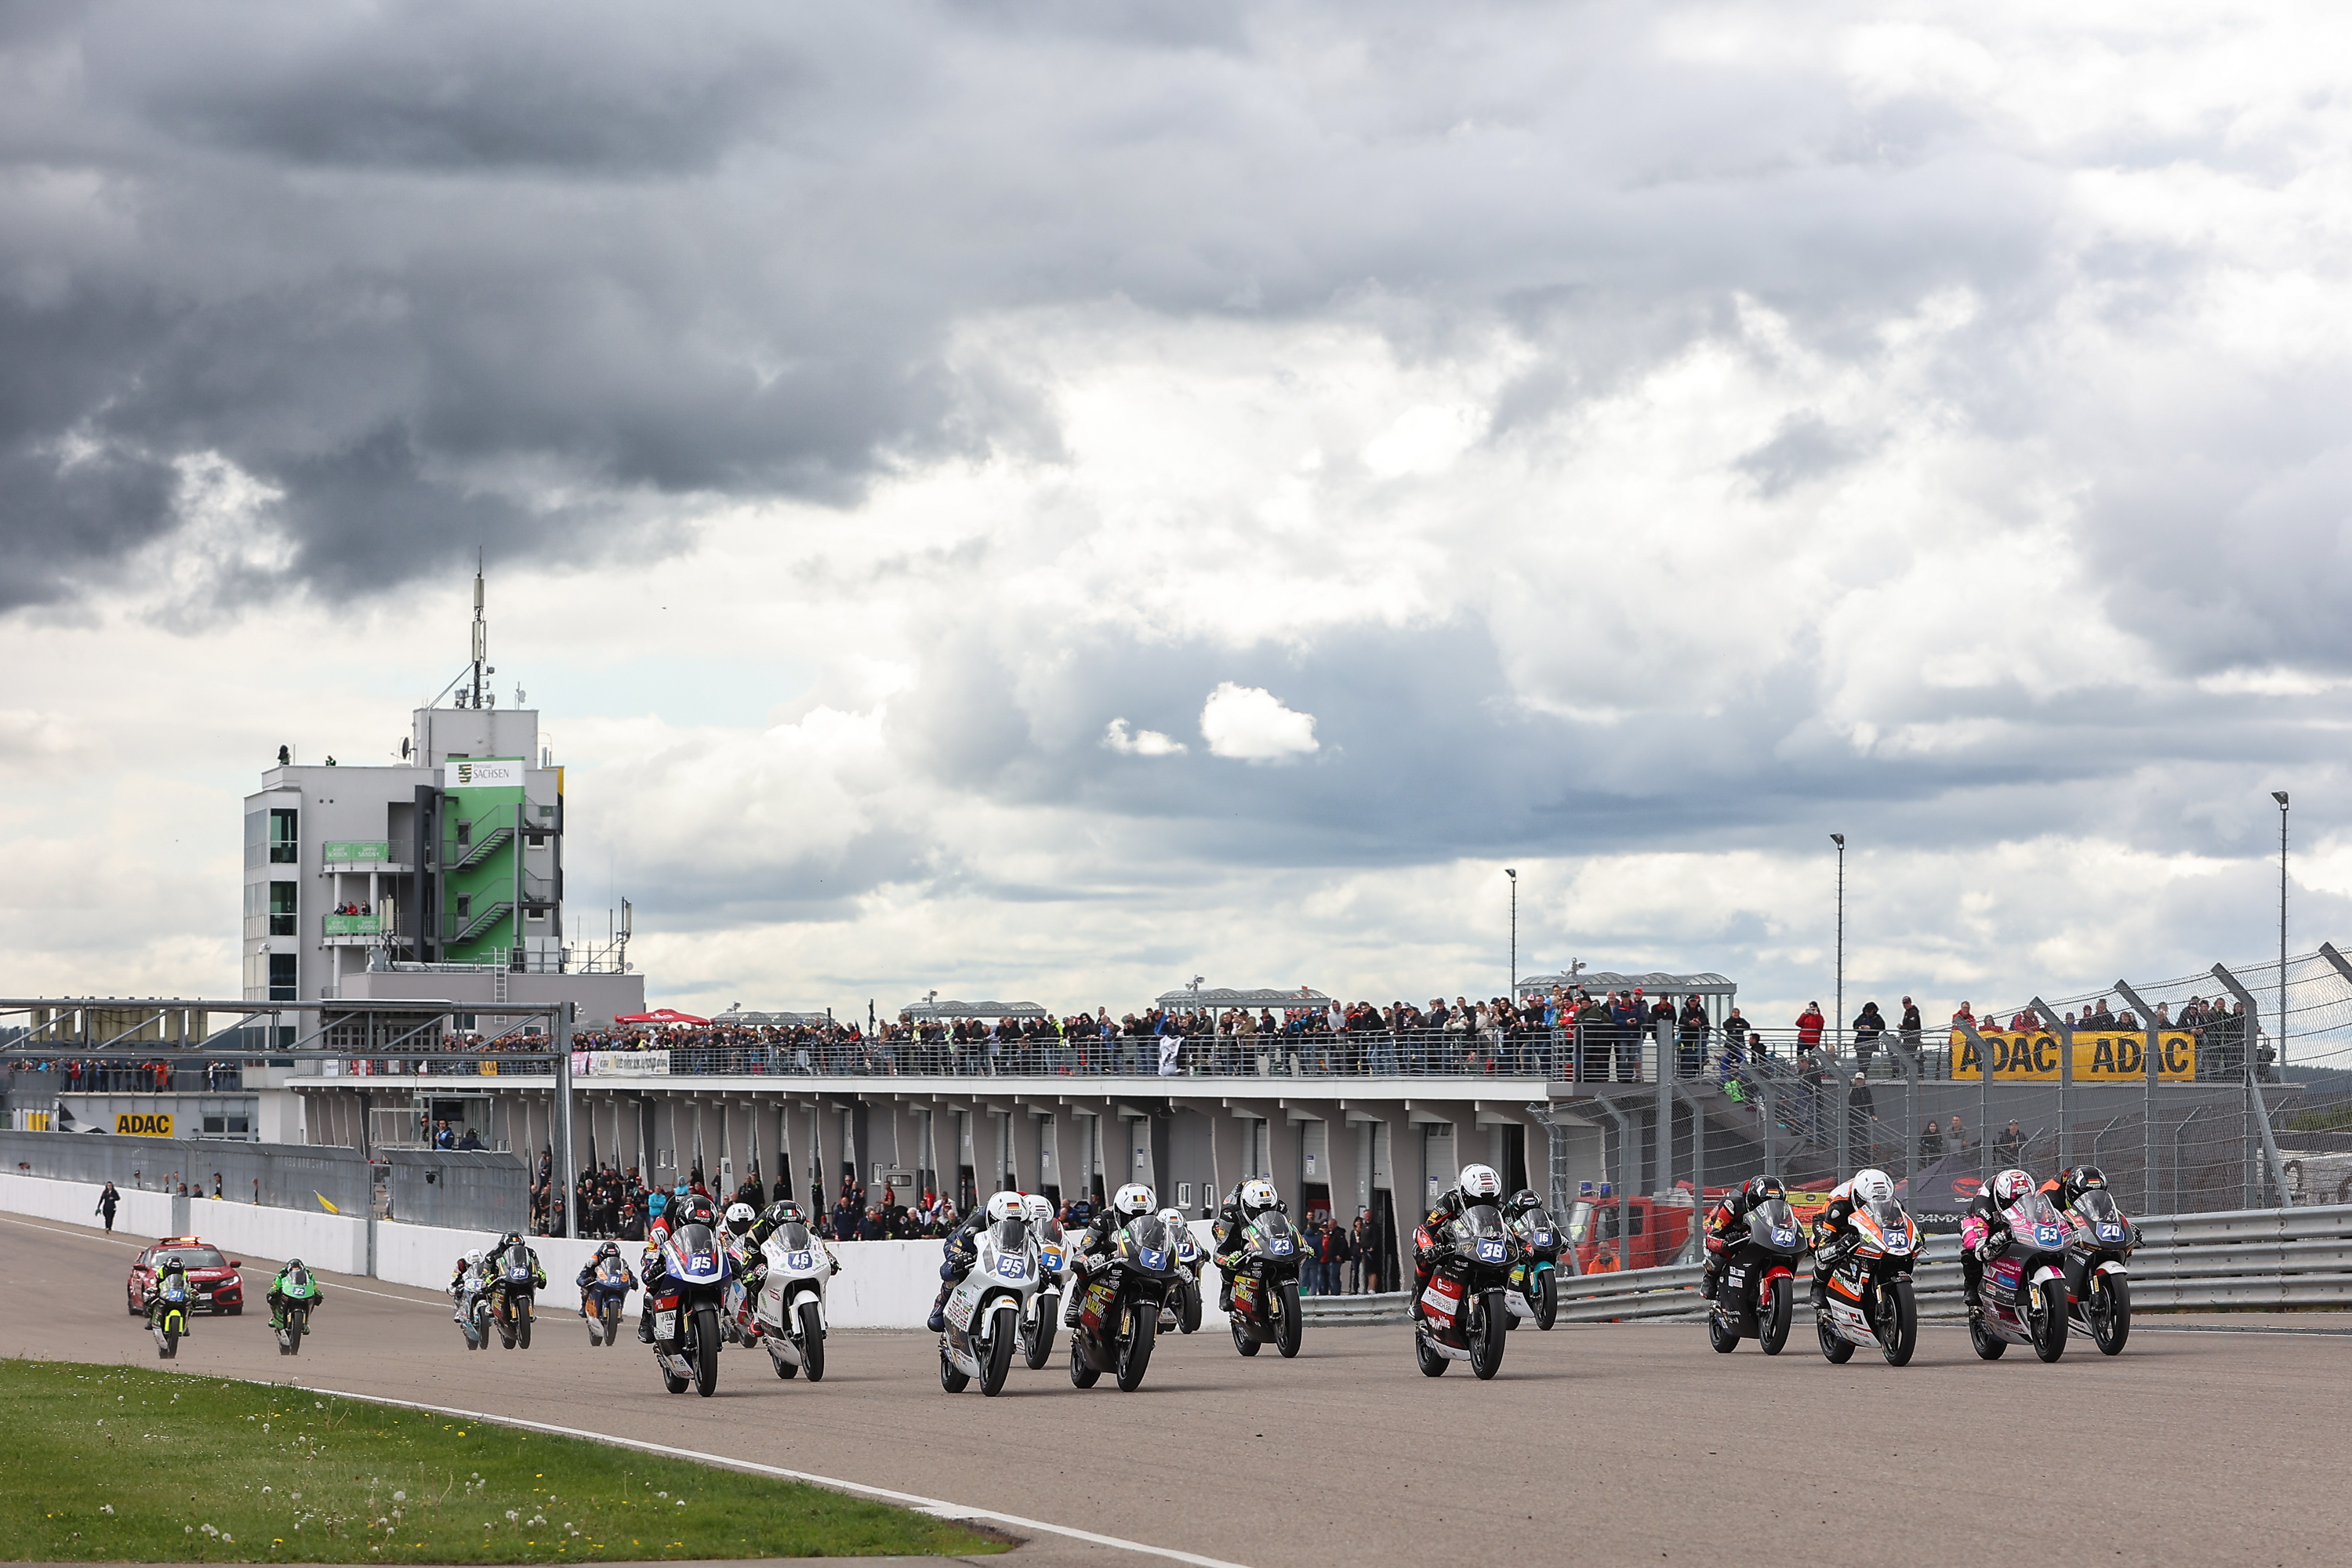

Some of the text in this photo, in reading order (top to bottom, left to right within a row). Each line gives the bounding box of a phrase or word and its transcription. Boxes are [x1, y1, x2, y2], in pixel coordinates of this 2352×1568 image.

[474, 768, 510, 779] SACHSEN
[1960, 1036, 2057, 1073] ADAC
[117, 1115, 170, 1134] ADAC
[1538, 1233, 1548, 1242] 16
[1775, 1230, 1793, 1243] 26
[2040, 1227, 2058, 1240] 53
[2102, 1225, 2120, 1237] 20
[1888, 1232, 1905, 1245] 36
[1178, 1243, 1190, 1253] 17
[1274, 1240, 1290, 1251] 23
[1481, 1243, 1503, 1258] 38
[691, 1256, 711, 1270] 85
[792, 1254, 809, 1266] 46
[1047, 1254, 1058, 1267] 5
[1148, 1251, 1160, 1265] 2
[513, 1268, 526, 1277] 28
[1000, 1258, 1023, 1274] 95
